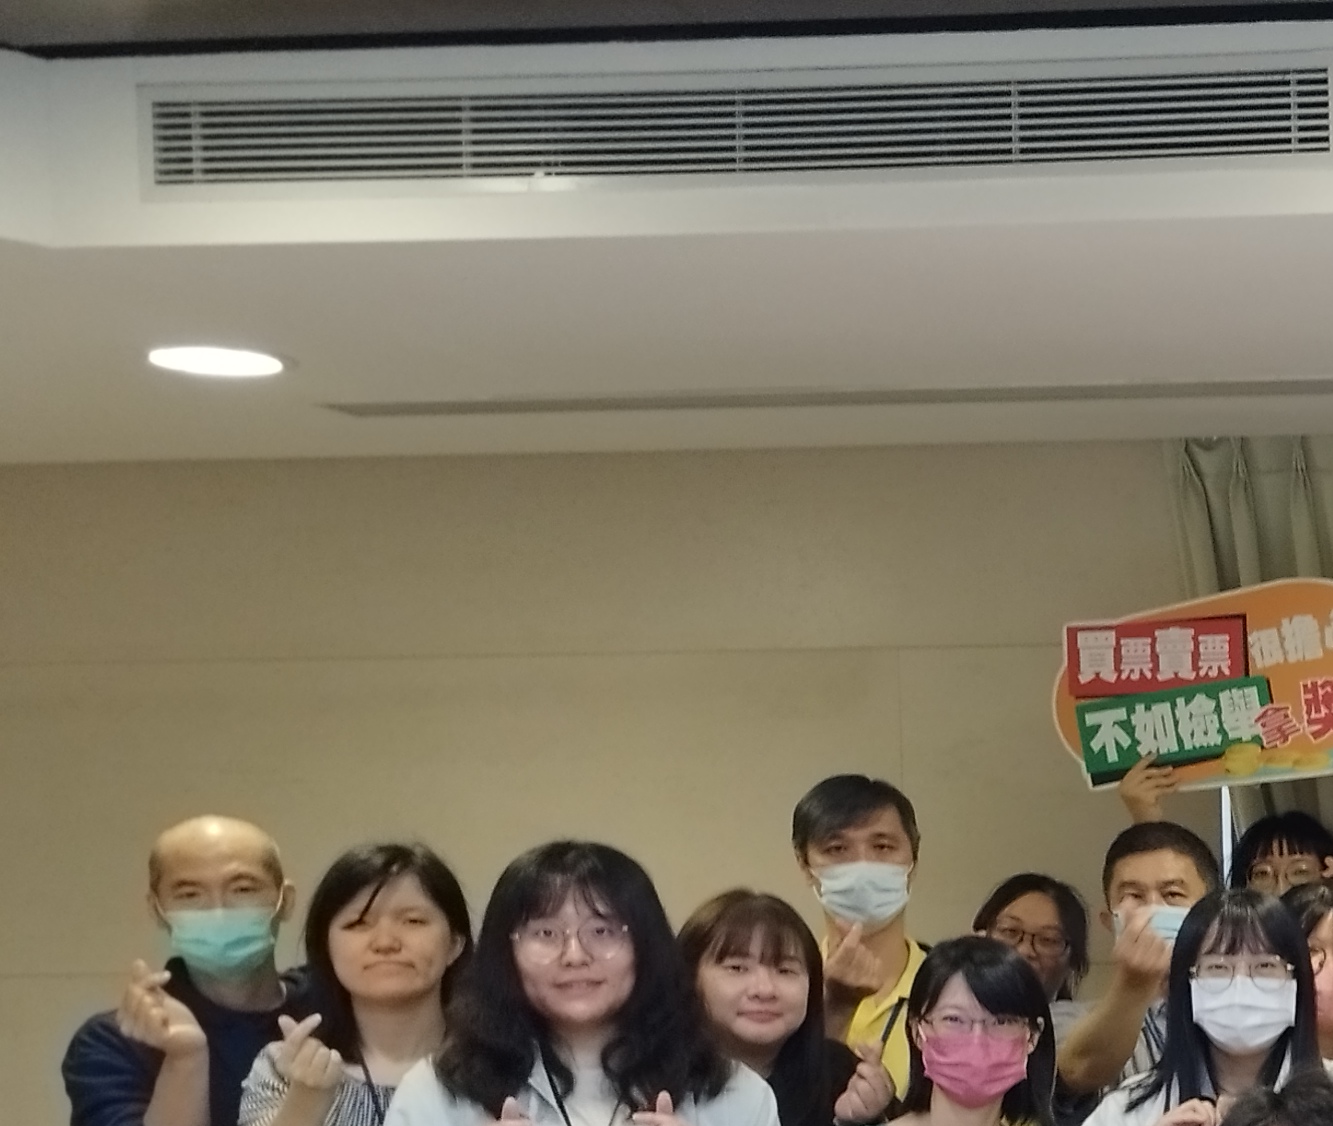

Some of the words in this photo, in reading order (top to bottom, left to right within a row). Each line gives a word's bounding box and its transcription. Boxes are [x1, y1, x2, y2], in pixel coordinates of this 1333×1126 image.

[1077, 626, 1231, 684] 買票賣票
[1085, 686, 1262, 764] 不如檢舉
